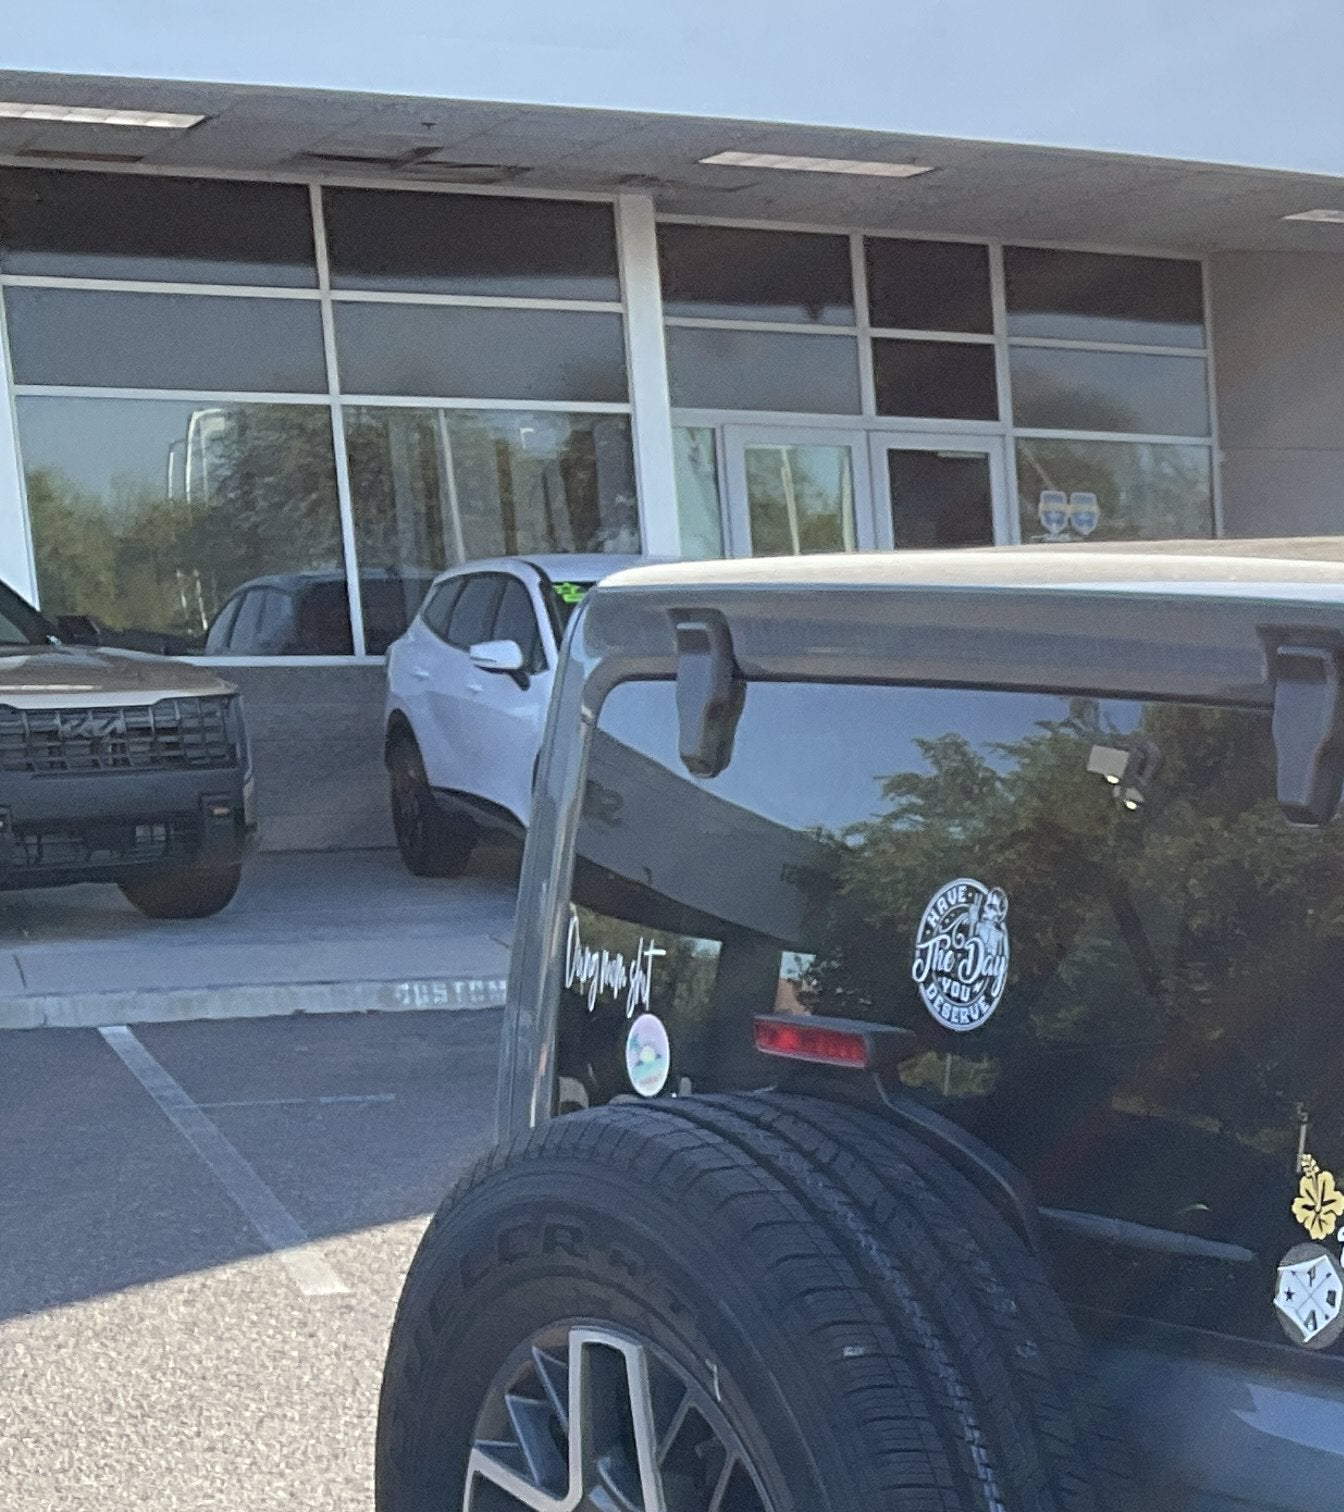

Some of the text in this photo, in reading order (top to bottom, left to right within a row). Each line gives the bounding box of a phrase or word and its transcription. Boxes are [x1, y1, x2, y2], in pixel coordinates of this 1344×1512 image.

[926, 884, 969, 928] HAVE
[911, 933, 1008, 998] The Day
[925, 983, 992, 1025] DESERVE
[941, 977, 971, 1003] YOU
